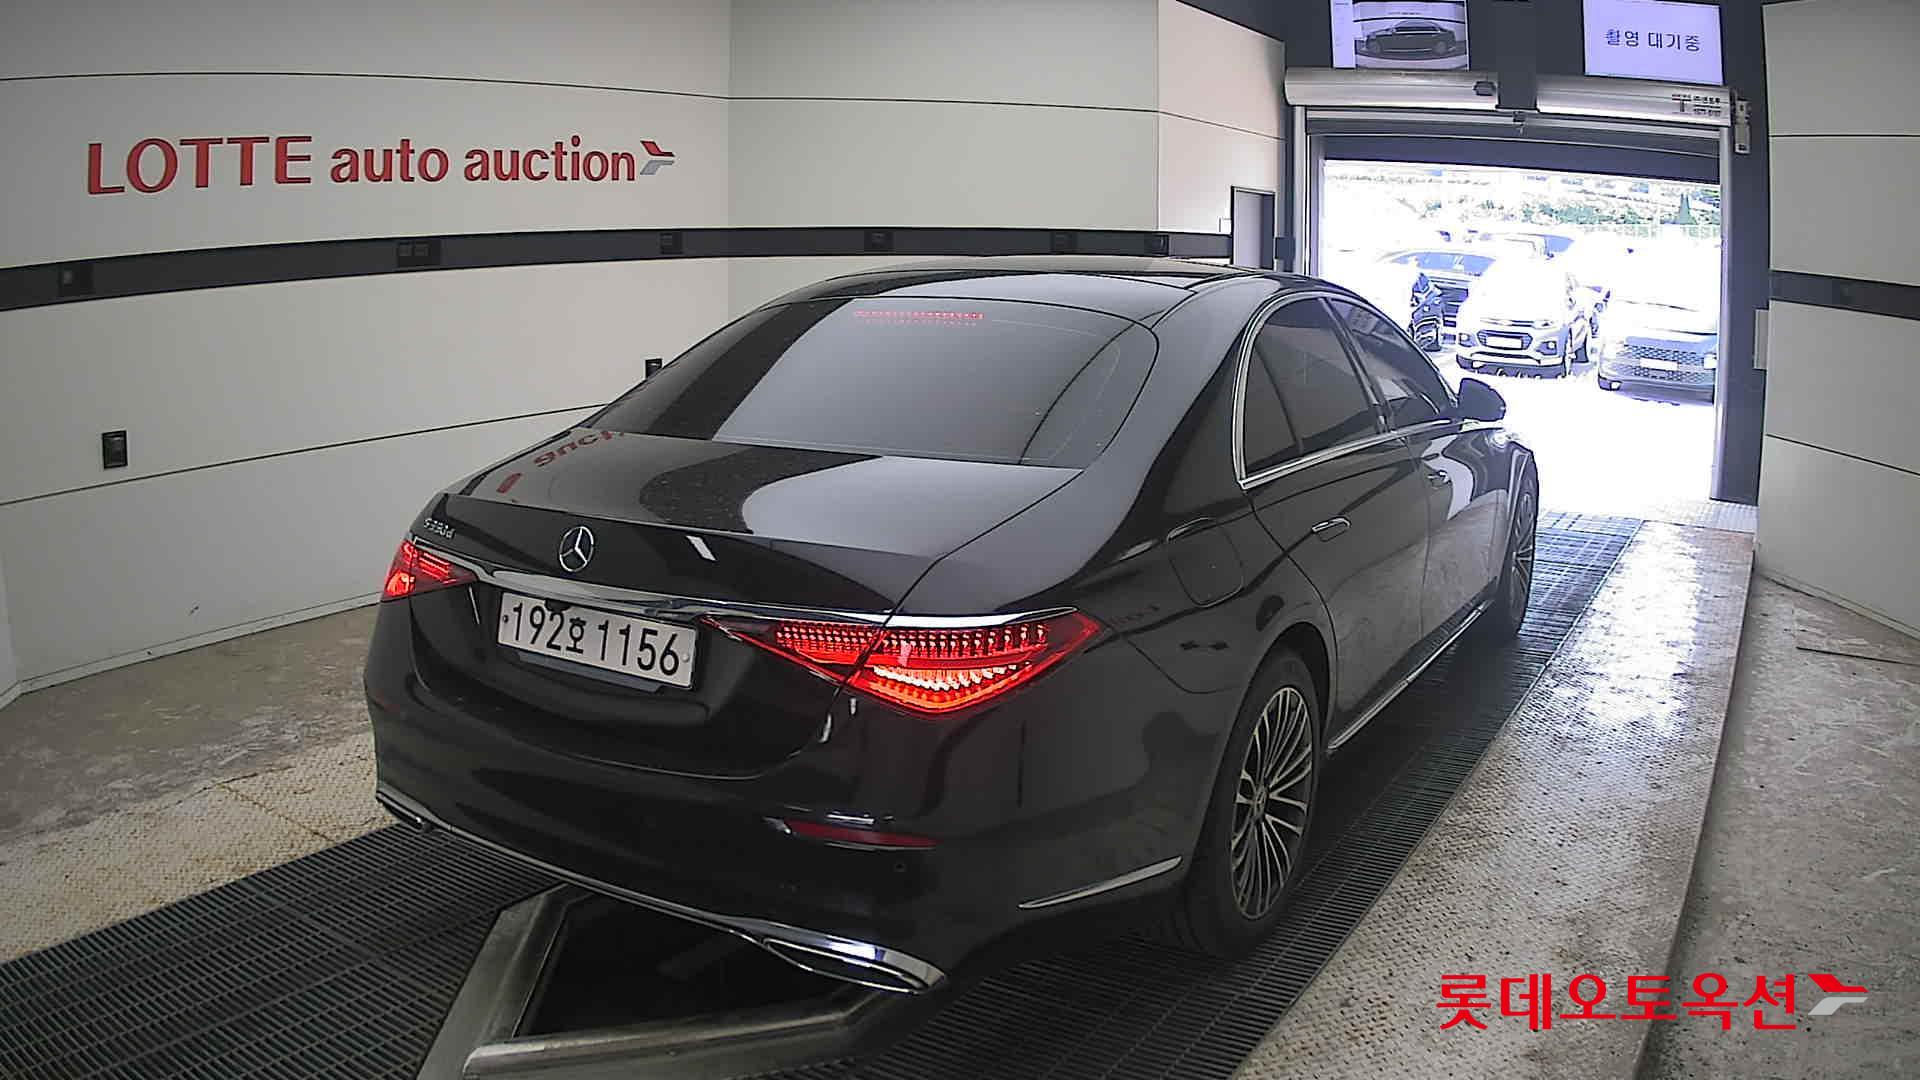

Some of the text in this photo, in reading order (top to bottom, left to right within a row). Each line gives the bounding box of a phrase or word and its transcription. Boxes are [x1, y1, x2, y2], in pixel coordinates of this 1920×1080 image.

[1648, 31, 1701, 52] 대기중
[87, 134, 636, 195] LOTTE auto auction
[513, 602, 680, 676] 192호 1156
